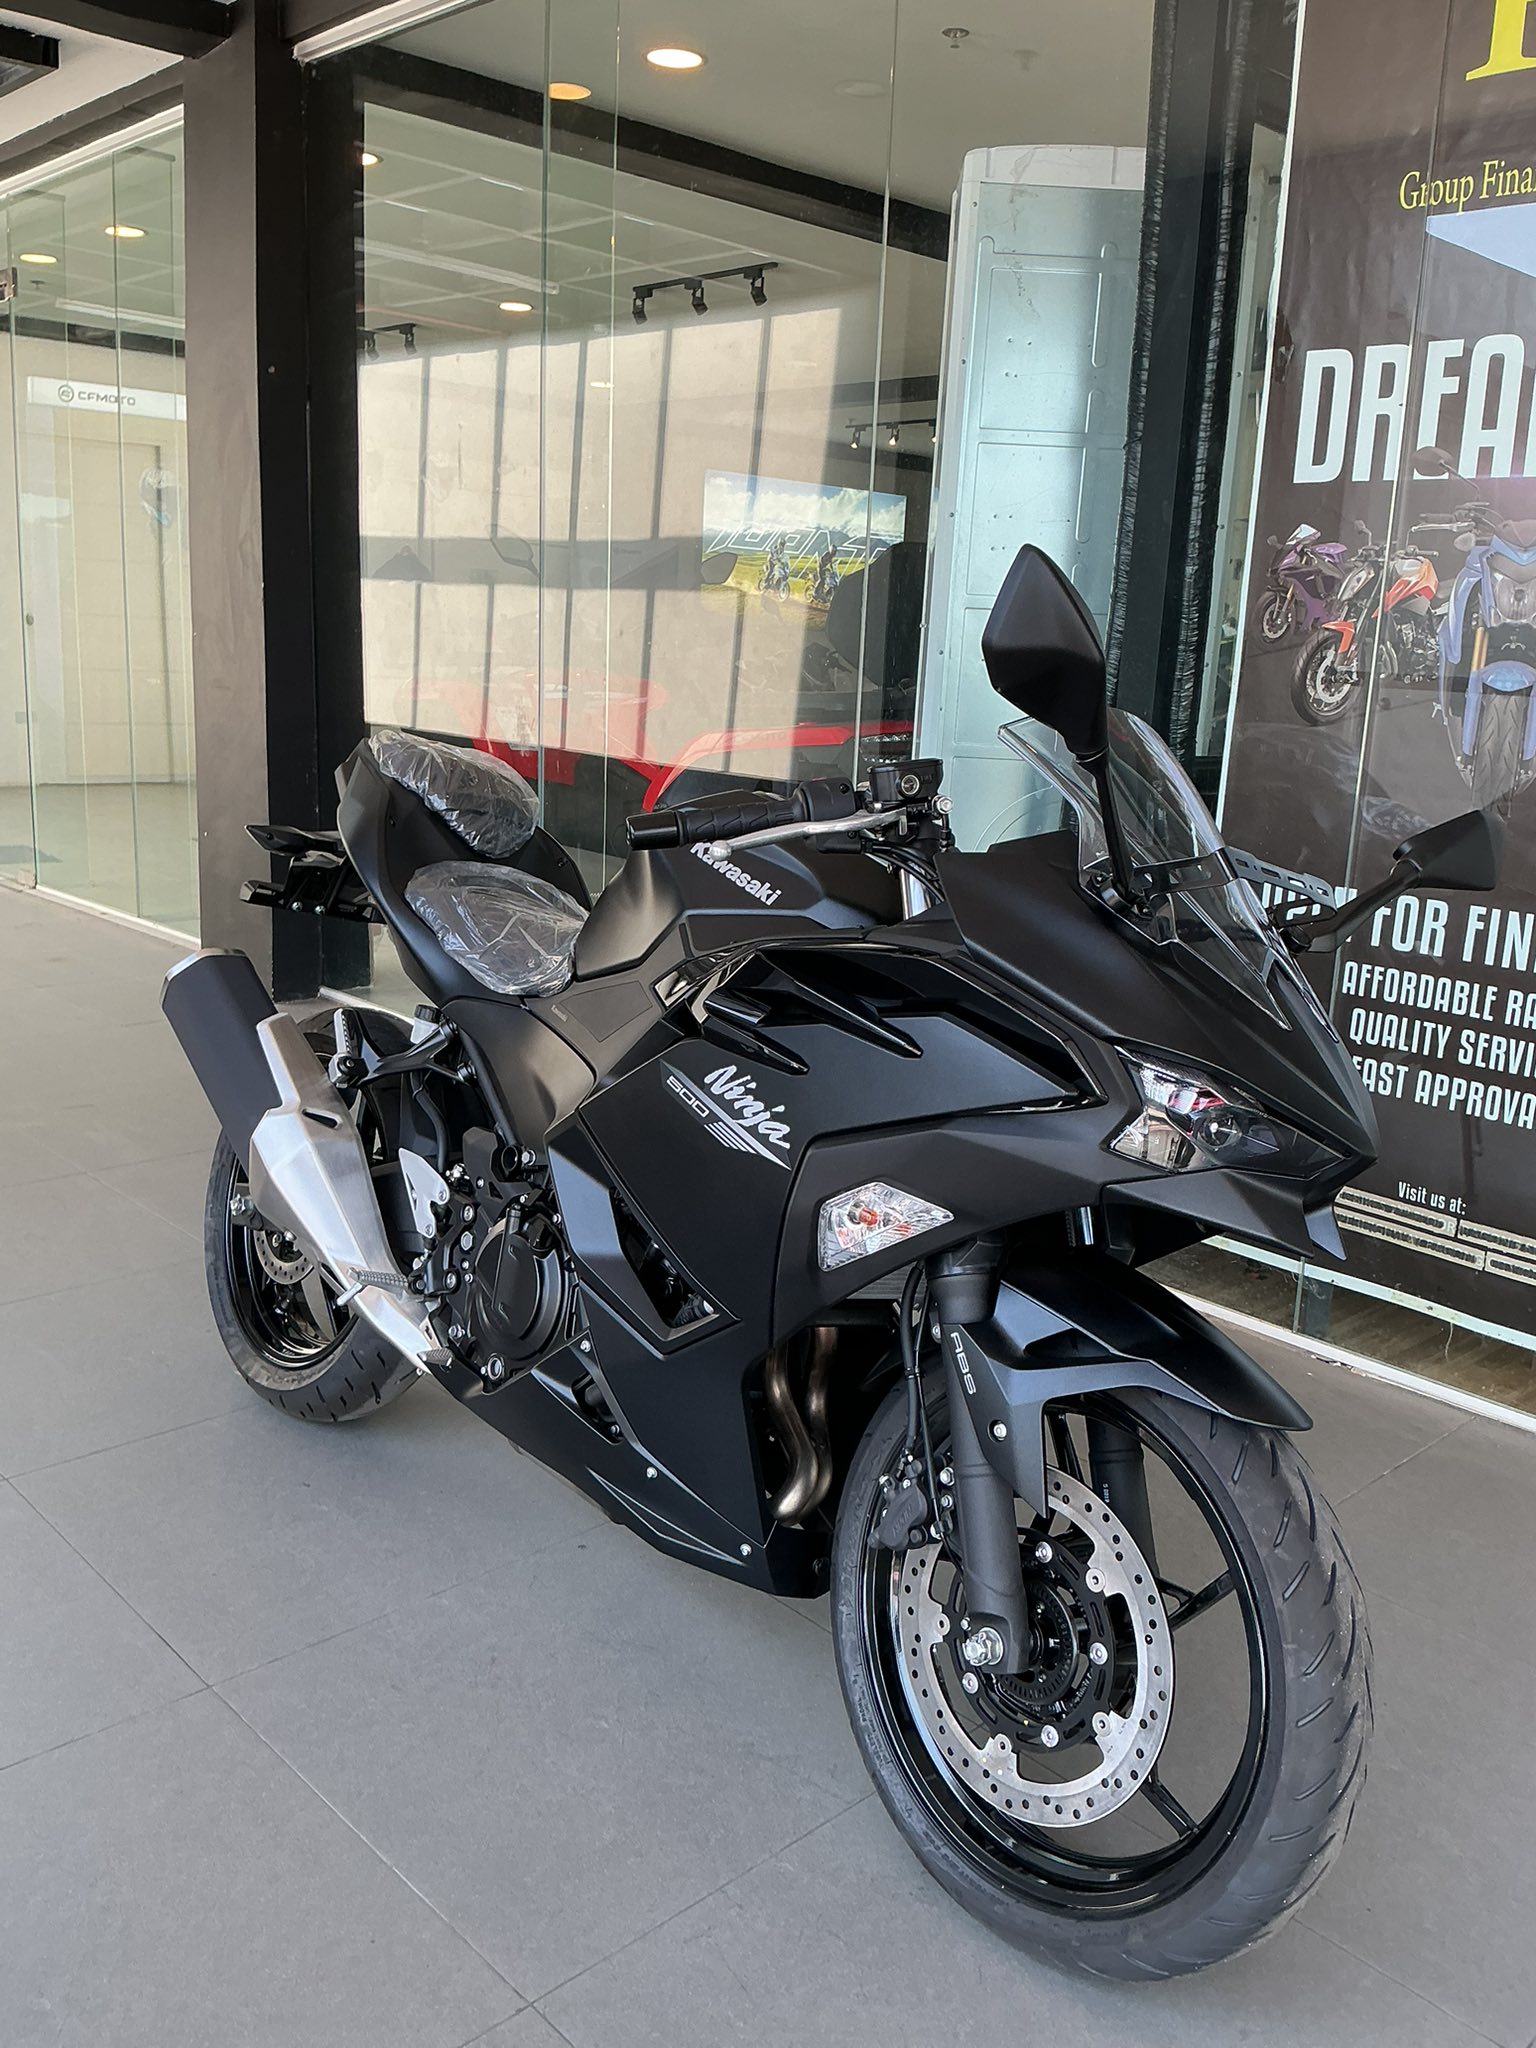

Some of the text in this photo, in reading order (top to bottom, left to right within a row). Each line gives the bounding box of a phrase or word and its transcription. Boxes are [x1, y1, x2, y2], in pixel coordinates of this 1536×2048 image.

[1399, 160, 1536, 216] Group Fina
[1293, 334, 1536, 484] DREA
[690, 841, 782, 906] Kawasaki
[1462, 905, 1536, 973] FIN
[1342, 961, 1498, 1022] AFFORDABLE
[1350, 1007, 1536, 1079] QUALITY SERVI
[666, 1075, 710, 1118] 500
[703, 1064, 791, 1150] Ninja
[1398, 1181, 1467, 1216] Visit us at:
[950, 1331, 977, 1395] ABS
